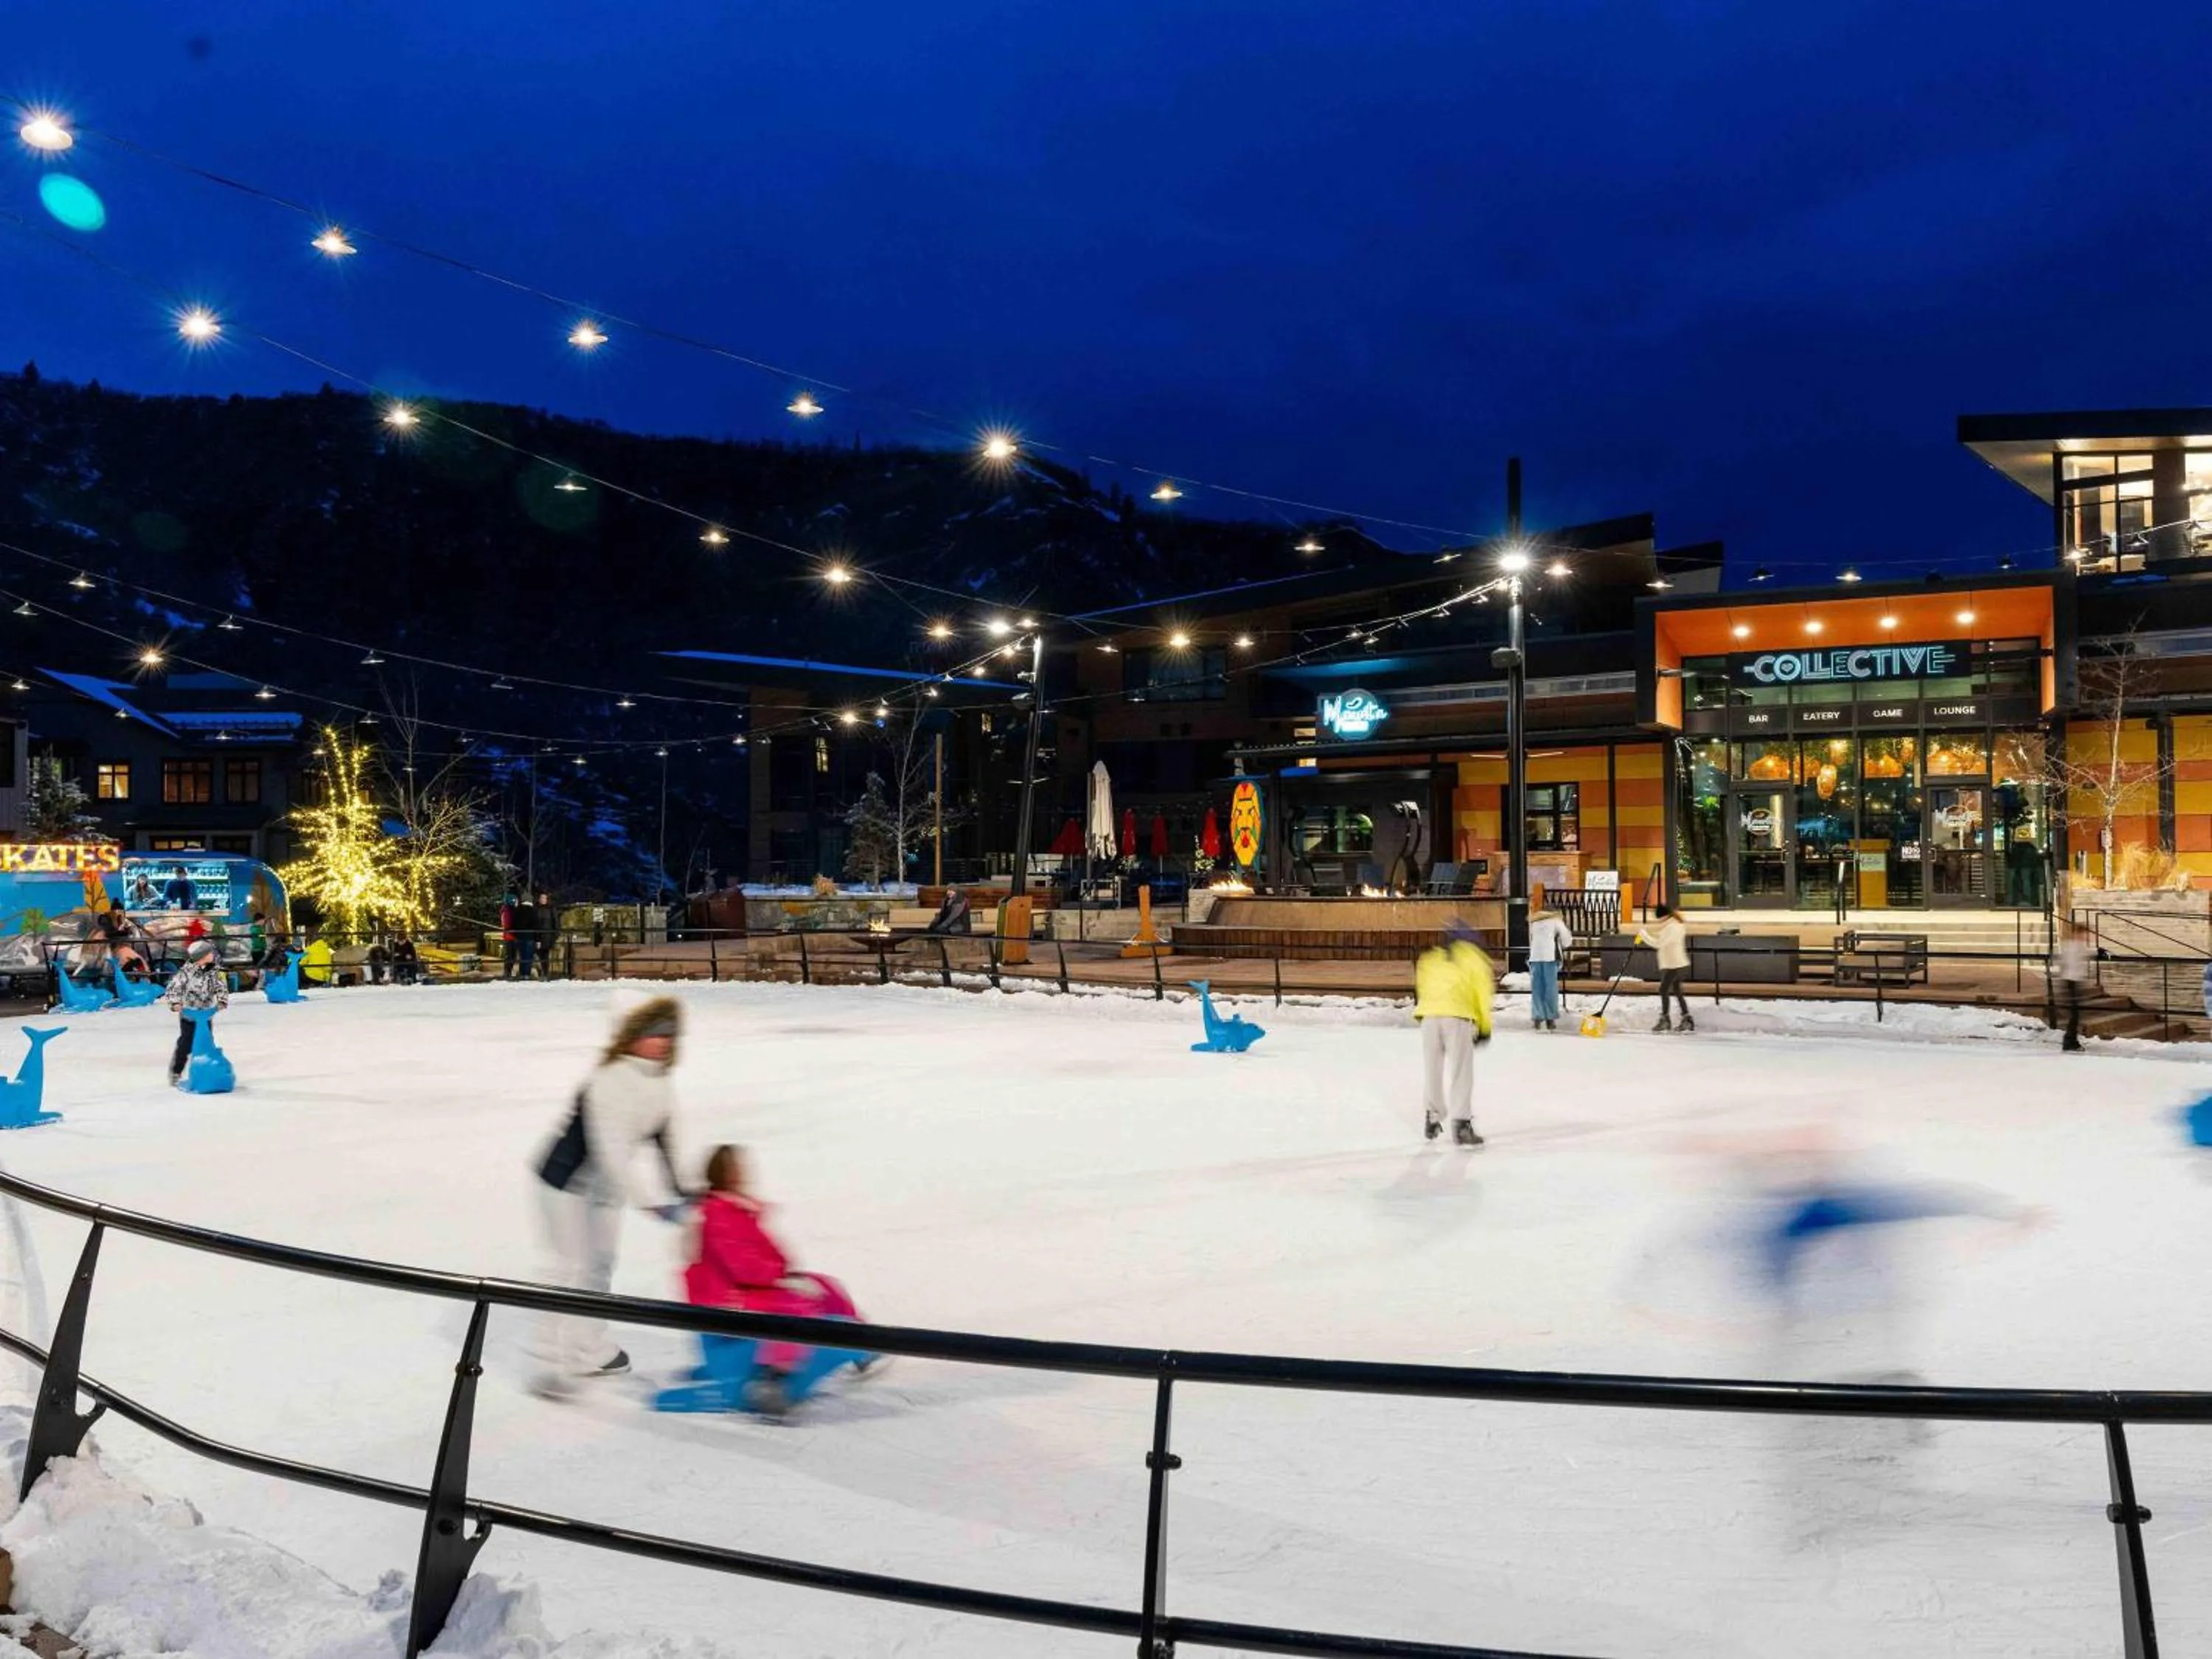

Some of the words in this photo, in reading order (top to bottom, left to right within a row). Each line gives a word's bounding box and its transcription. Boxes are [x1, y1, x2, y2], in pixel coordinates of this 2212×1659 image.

[1744, 645, 1955, 682] COLLECTIVE
[1748, 714, 1769, 724] BAR
[1803, 711, 1840, 721] EATERY
[1873, 708, 1903, 718] GAME
[1933, 705, 1977, 716] LOUNGE
[0, 844, 119, 872] KATES
